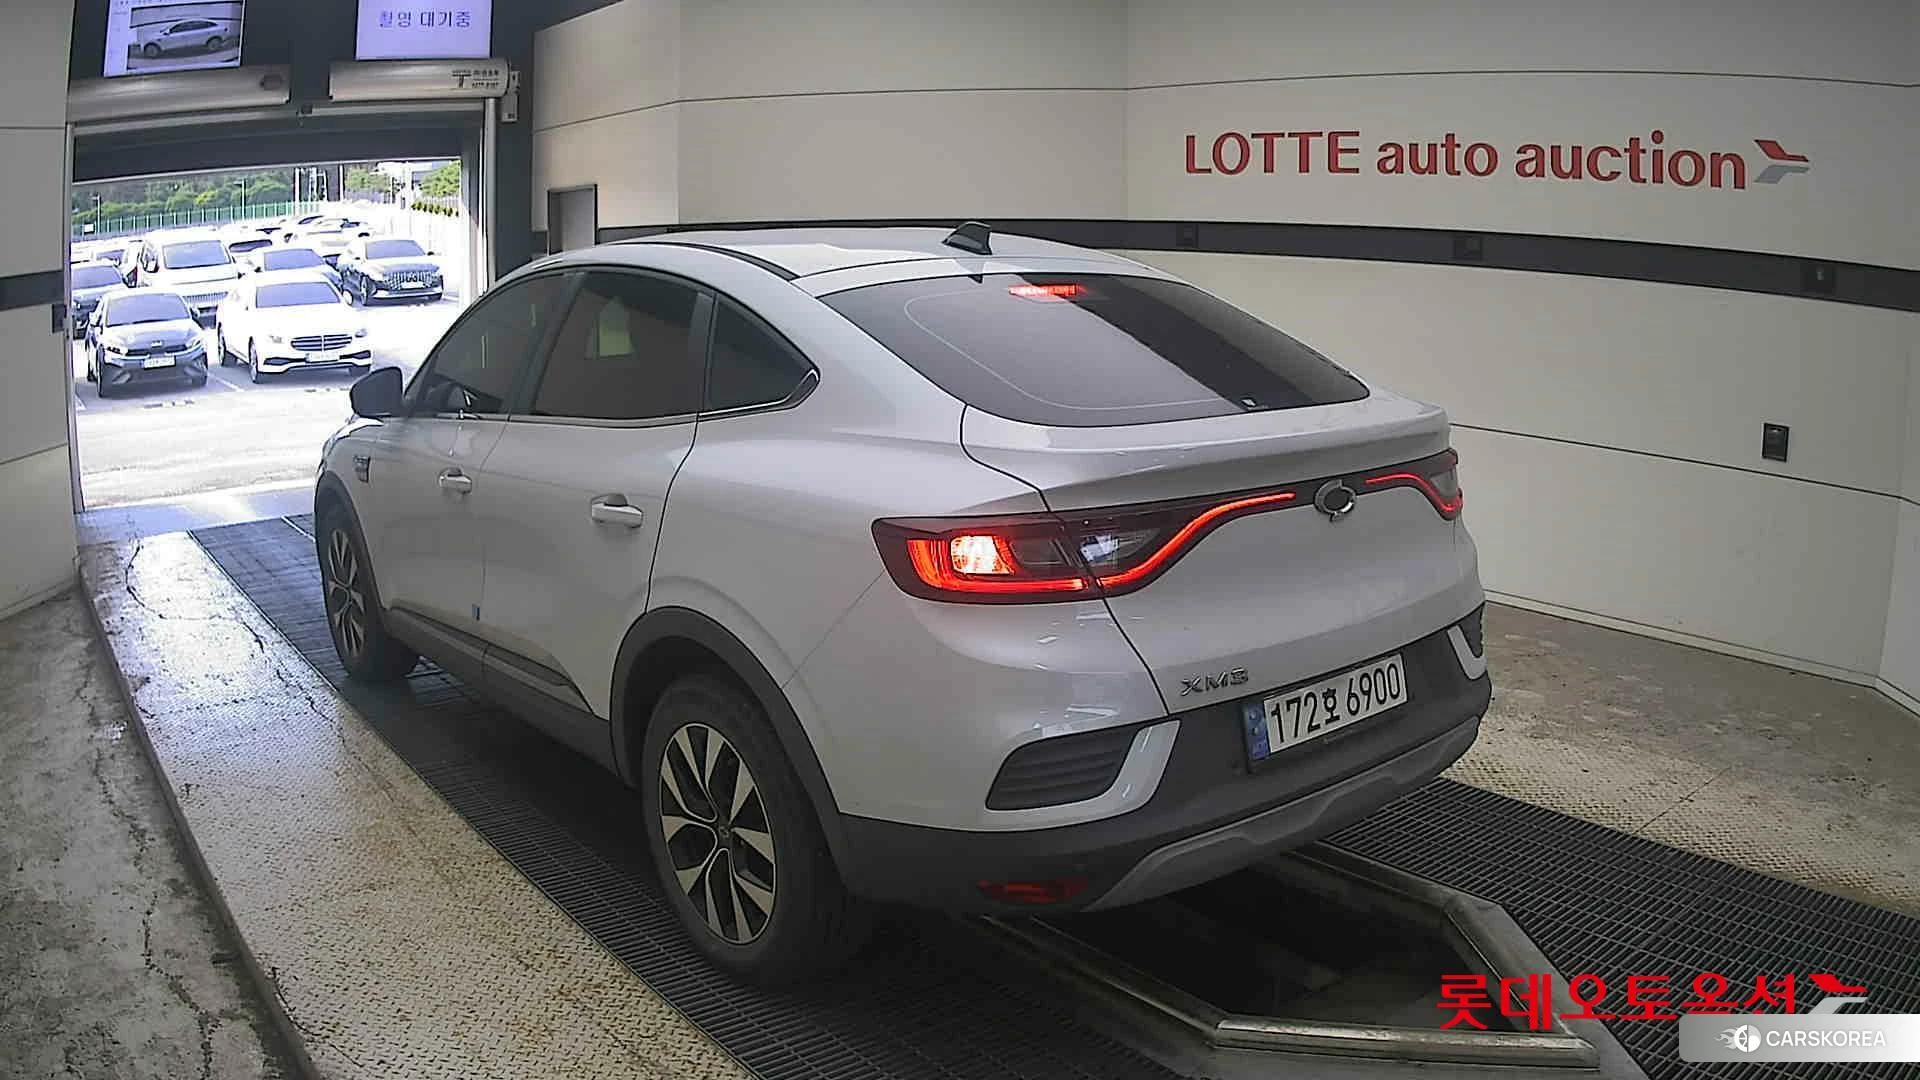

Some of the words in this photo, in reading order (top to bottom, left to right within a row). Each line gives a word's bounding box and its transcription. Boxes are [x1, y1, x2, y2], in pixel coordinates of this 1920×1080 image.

[420, 10, 471, 28] 대기중
[1185, 131, 1360, 175] LOTTE
[1377, 133, 1498, 177] auto
[1516, 130, 1746, 189] auction
[1180, 667, 1249, 696] XM3
[1271, 687, 1341, 744] 172호
[1346, 663, 1401, 717] 6900
